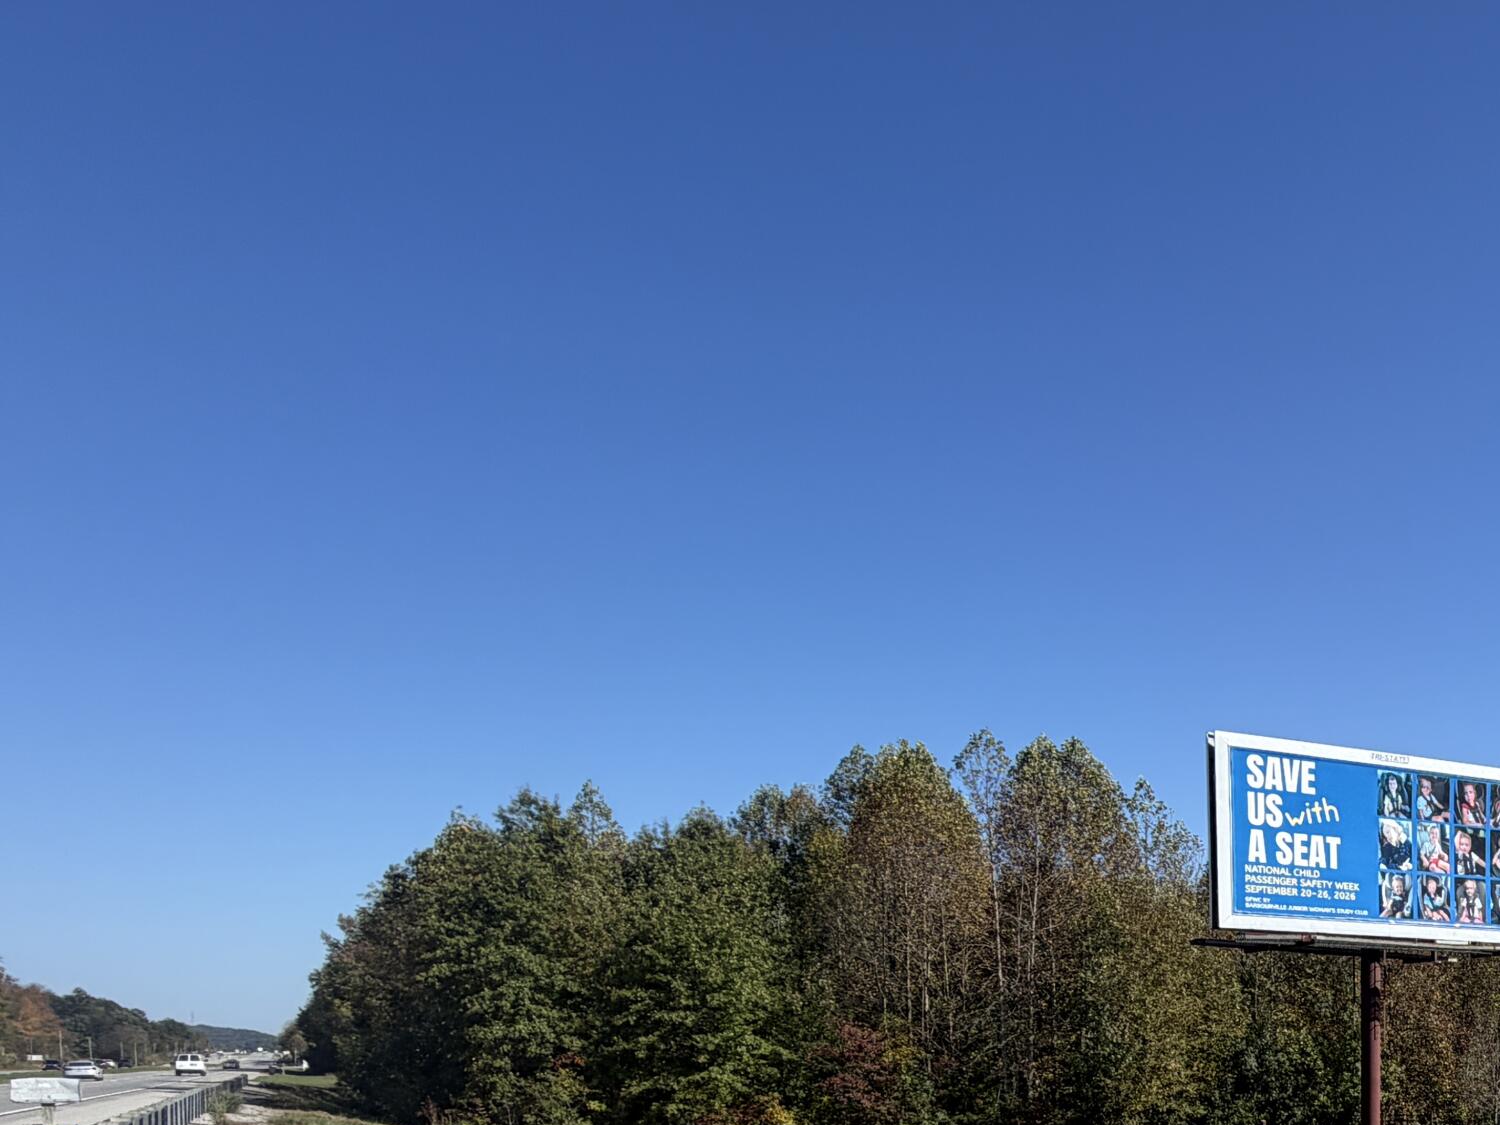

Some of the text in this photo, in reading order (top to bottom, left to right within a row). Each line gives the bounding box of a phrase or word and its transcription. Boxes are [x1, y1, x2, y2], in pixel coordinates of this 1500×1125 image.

[1246, 754, 1316, 795] SAVE
[1247, 791, 1340, 828] US with
[1248, 829, 1342, 870] A SEAT
[1245, 864, 1320, 878] NATIONAL CHILD
[1245, 874, 1360, 891] PASSENGER SAFETY WEEK
[1245, 884, 1356, 901] SEPTEMBER 20-26, 2026
